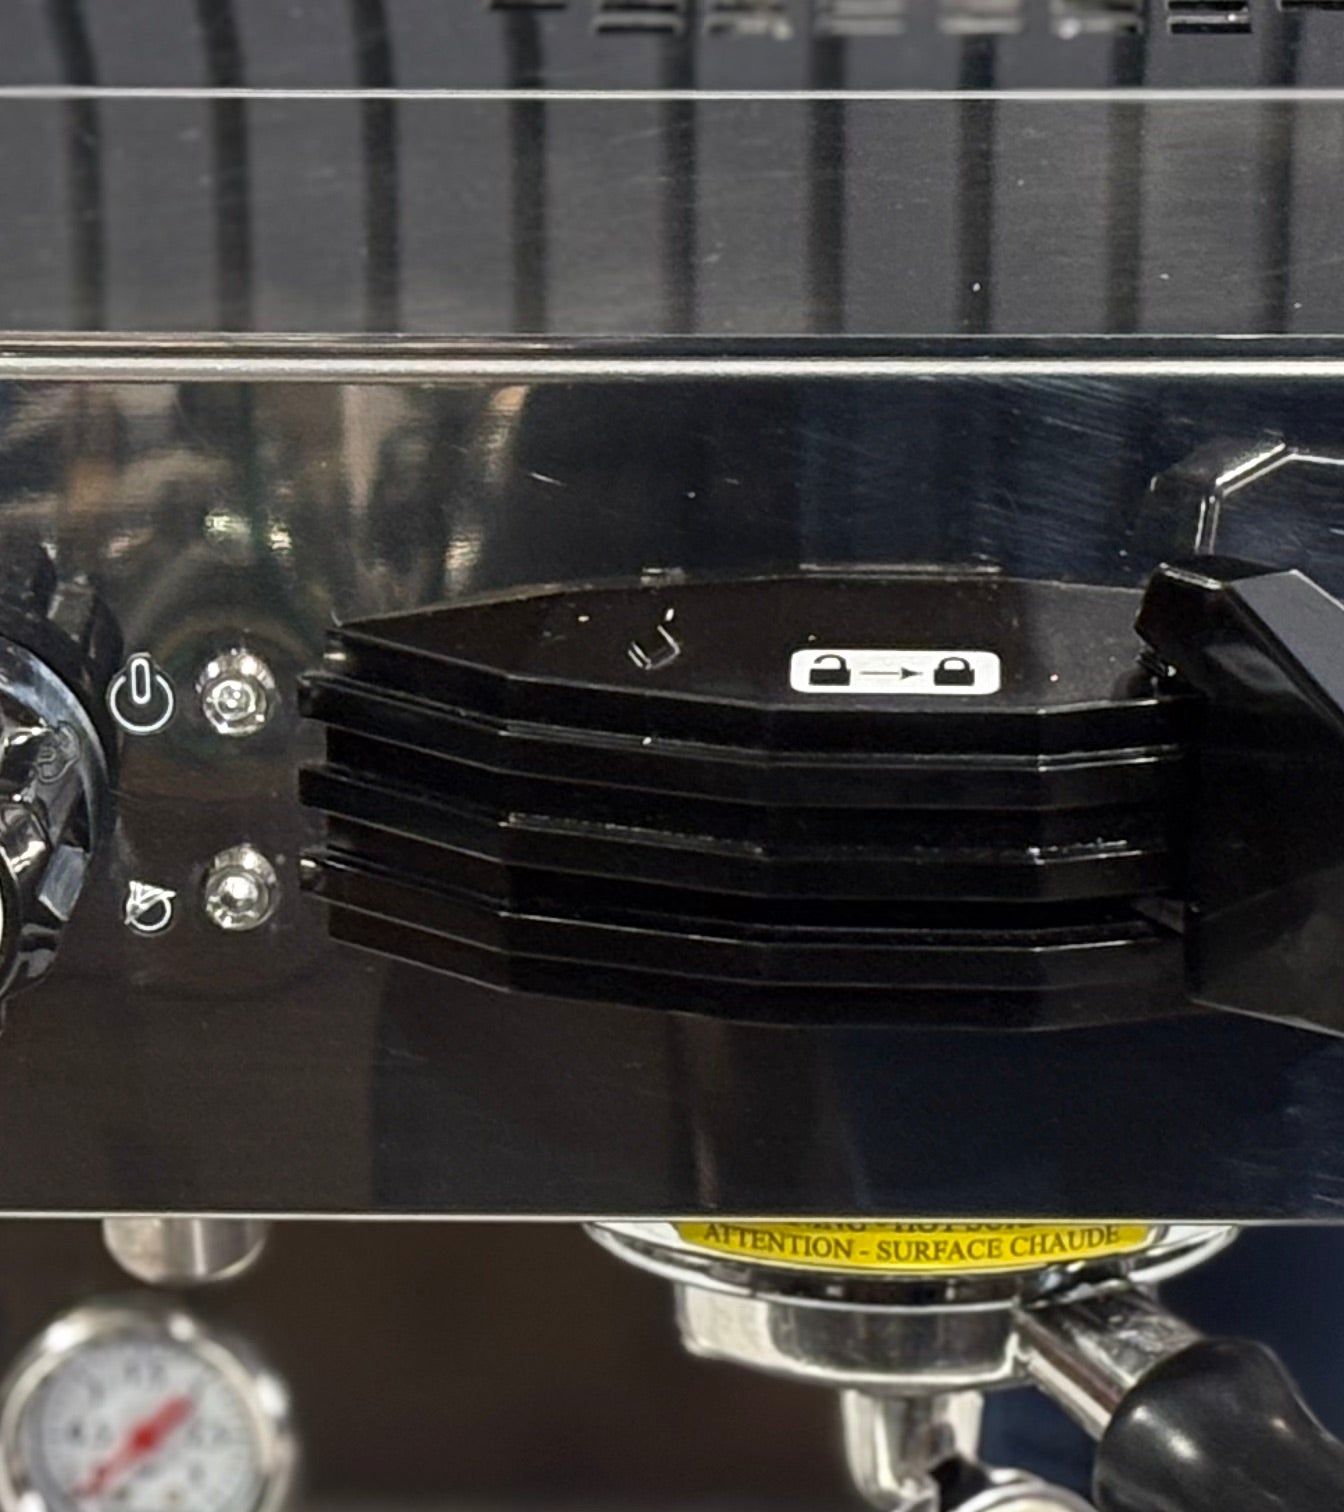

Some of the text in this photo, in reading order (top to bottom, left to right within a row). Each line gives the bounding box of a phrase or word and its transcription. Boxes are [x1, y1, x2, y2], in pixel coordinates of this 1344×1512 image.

[704, 1223, 853, 1259] ATTENTION
[875, 1238, 1003, 1262] SURFACE
[1009, 1225, 1120, 1257] CHAUDE
